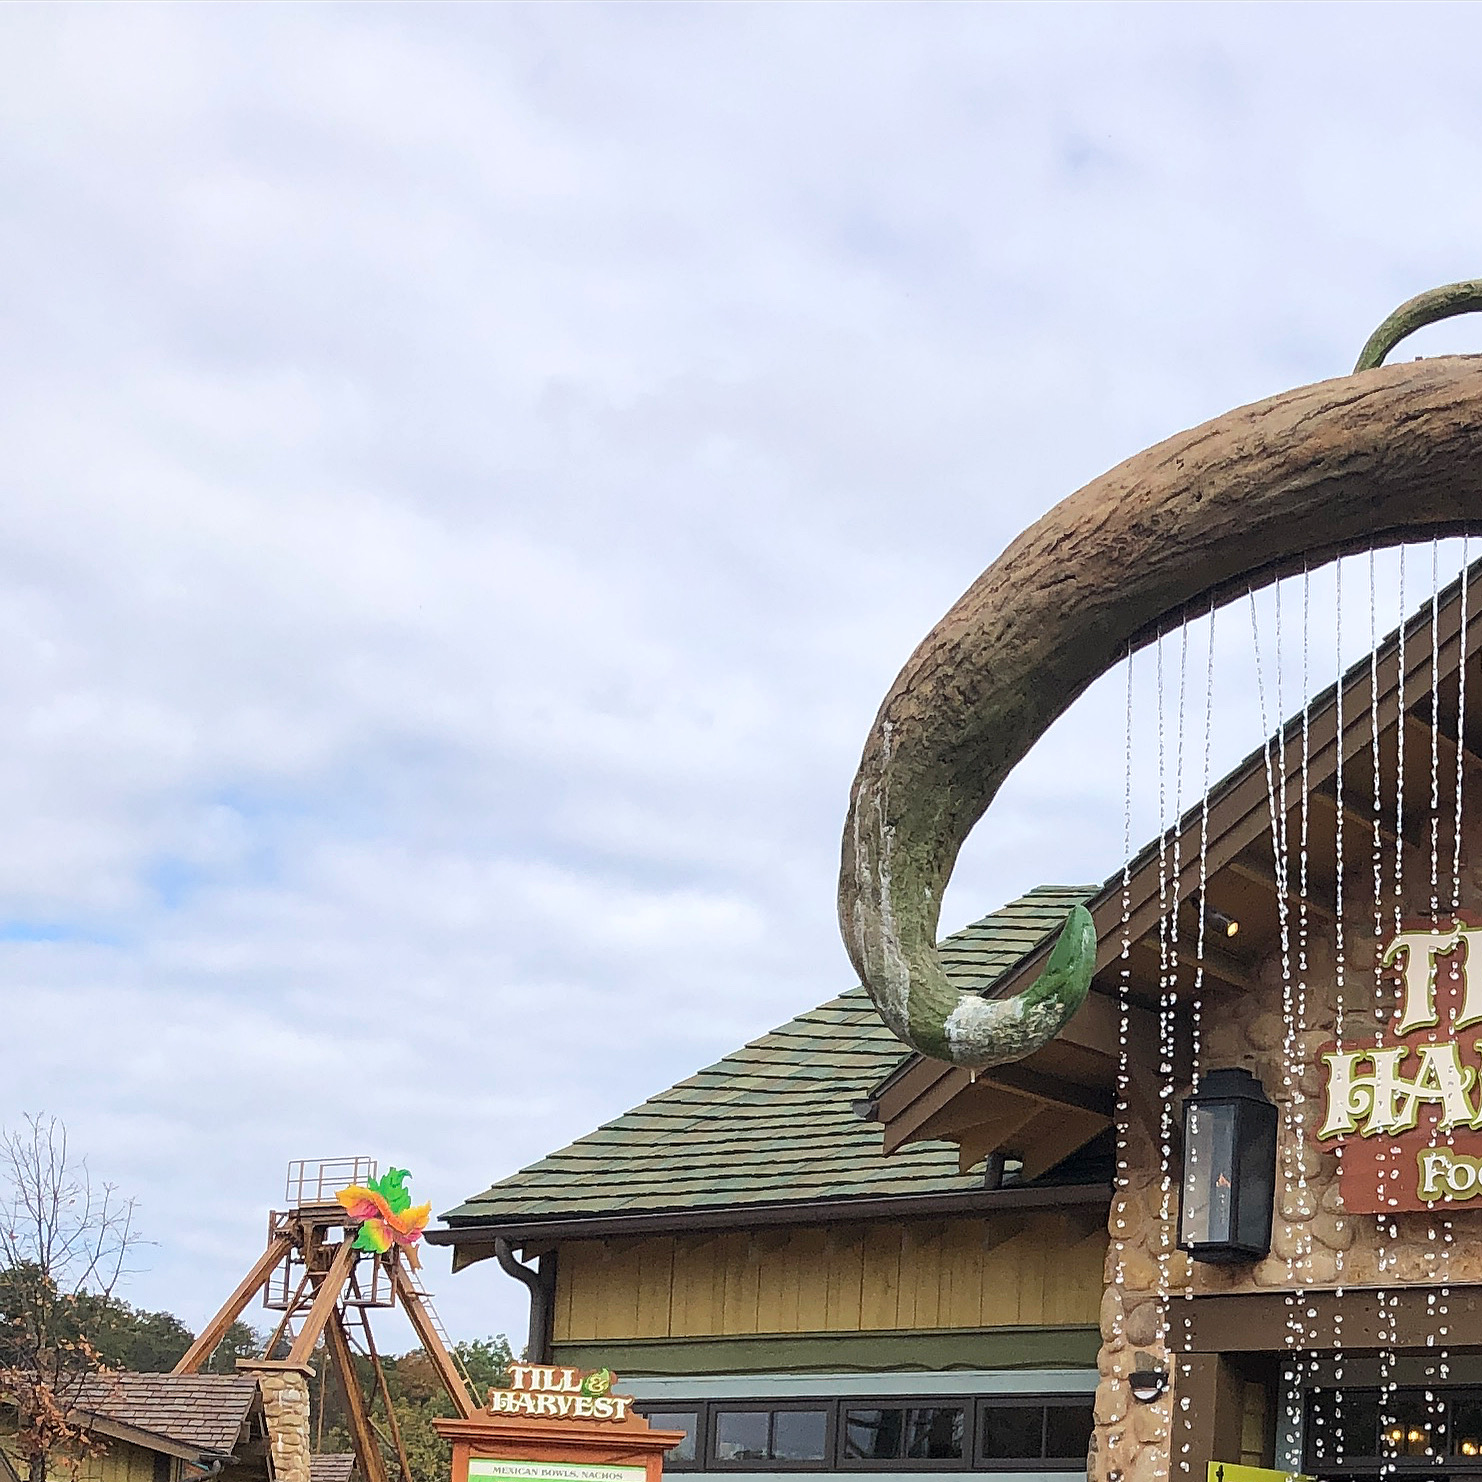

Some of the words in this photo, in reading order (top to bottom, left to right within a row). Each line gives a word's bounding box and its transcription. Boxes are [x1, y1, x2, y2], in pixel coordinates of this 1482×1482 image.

[508, 1366, 583, 1392] TILL
[588, 1375, 608, 1392] &
[491, 1391, 633, 1419] HARVEST
[492, 1466, 538, 1476] MEXICAN
[581, 1471, 624, 1480] NACHOS
